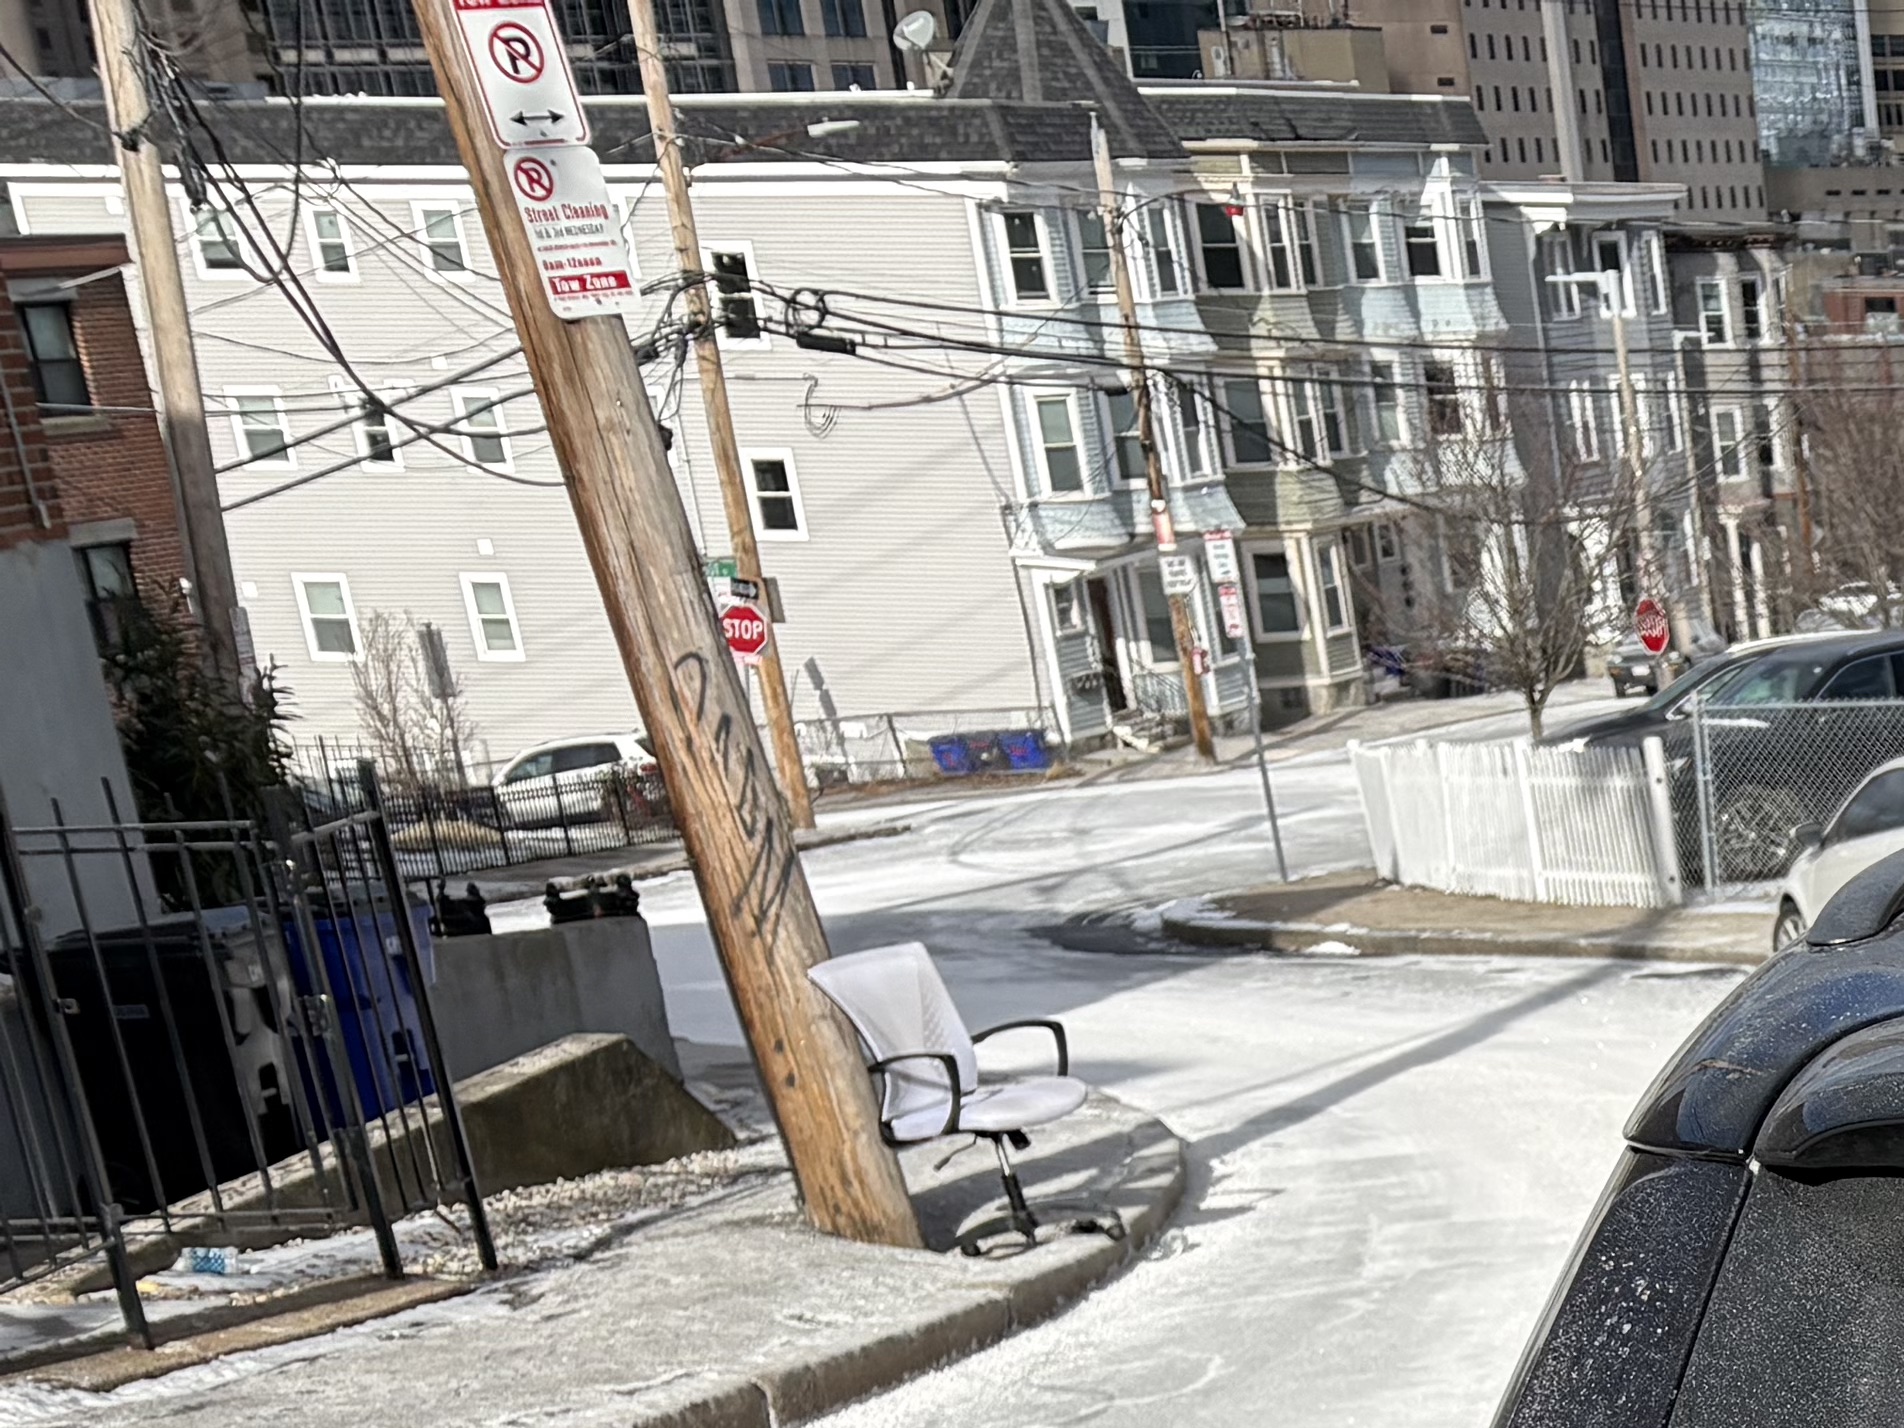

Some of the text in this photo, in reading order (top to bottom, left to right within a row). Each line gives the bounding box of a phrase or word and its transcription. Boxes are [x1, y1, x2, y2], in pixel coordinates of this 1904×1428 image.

[524, 202, 609, 223] Street Cleaning
[552, 274, 617, 293] Tow Zone
[723, 618, 763, 640] STOP
